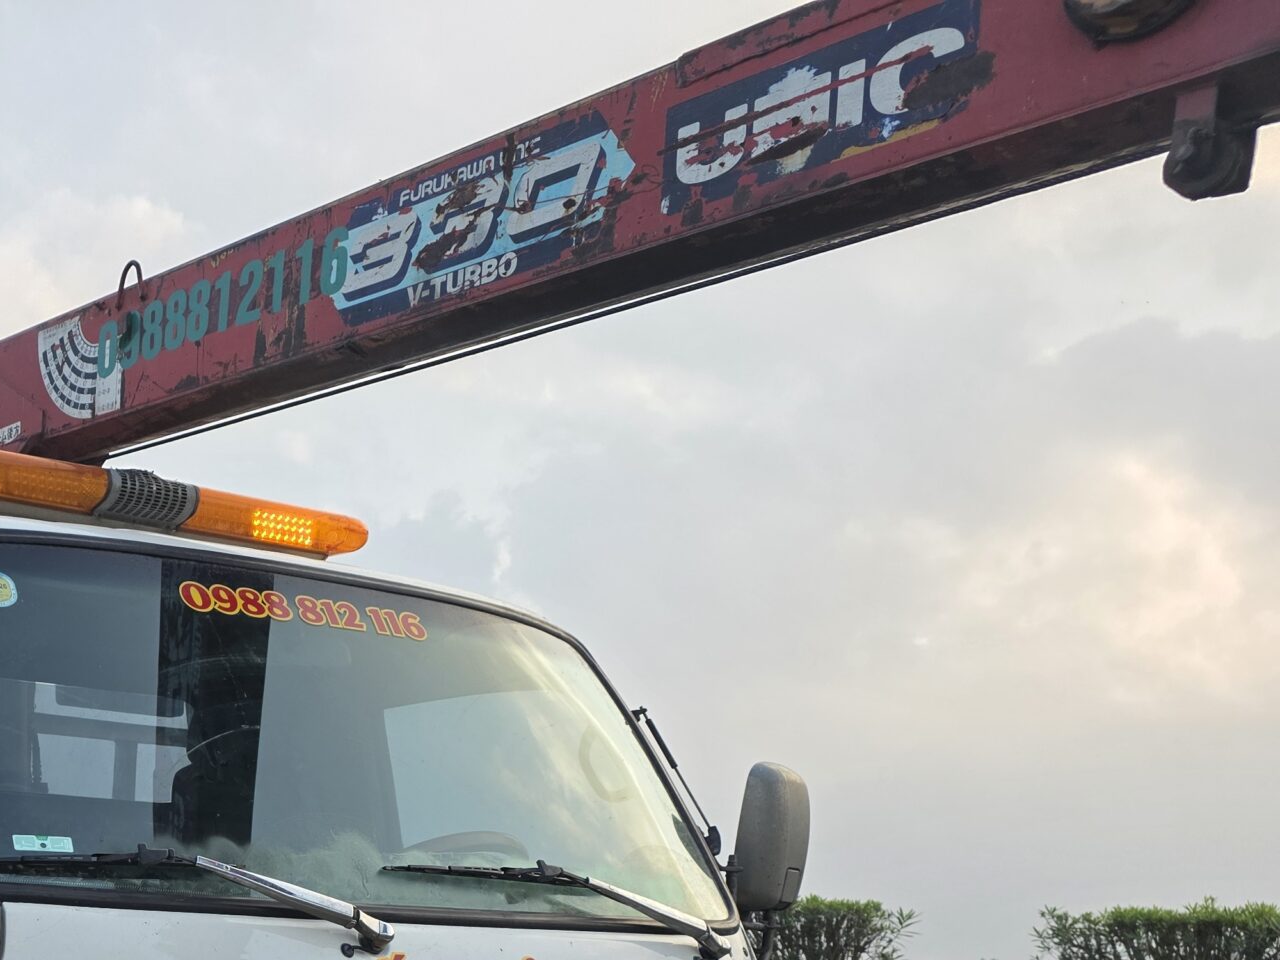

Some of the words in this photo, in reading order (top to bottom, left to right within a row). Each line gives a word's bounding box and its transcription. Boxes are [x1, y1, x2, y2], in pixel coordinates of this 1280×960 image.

[399, 155, 494, 207] FURUKAWA
[98, 227, 349, 379] 0988812116
[407, 252, 518, 308] V-TURBO
[178, 580, 293, 621] 0988
[295, 595, 367, 632] 812
[366, 606, 428, 641] 116
